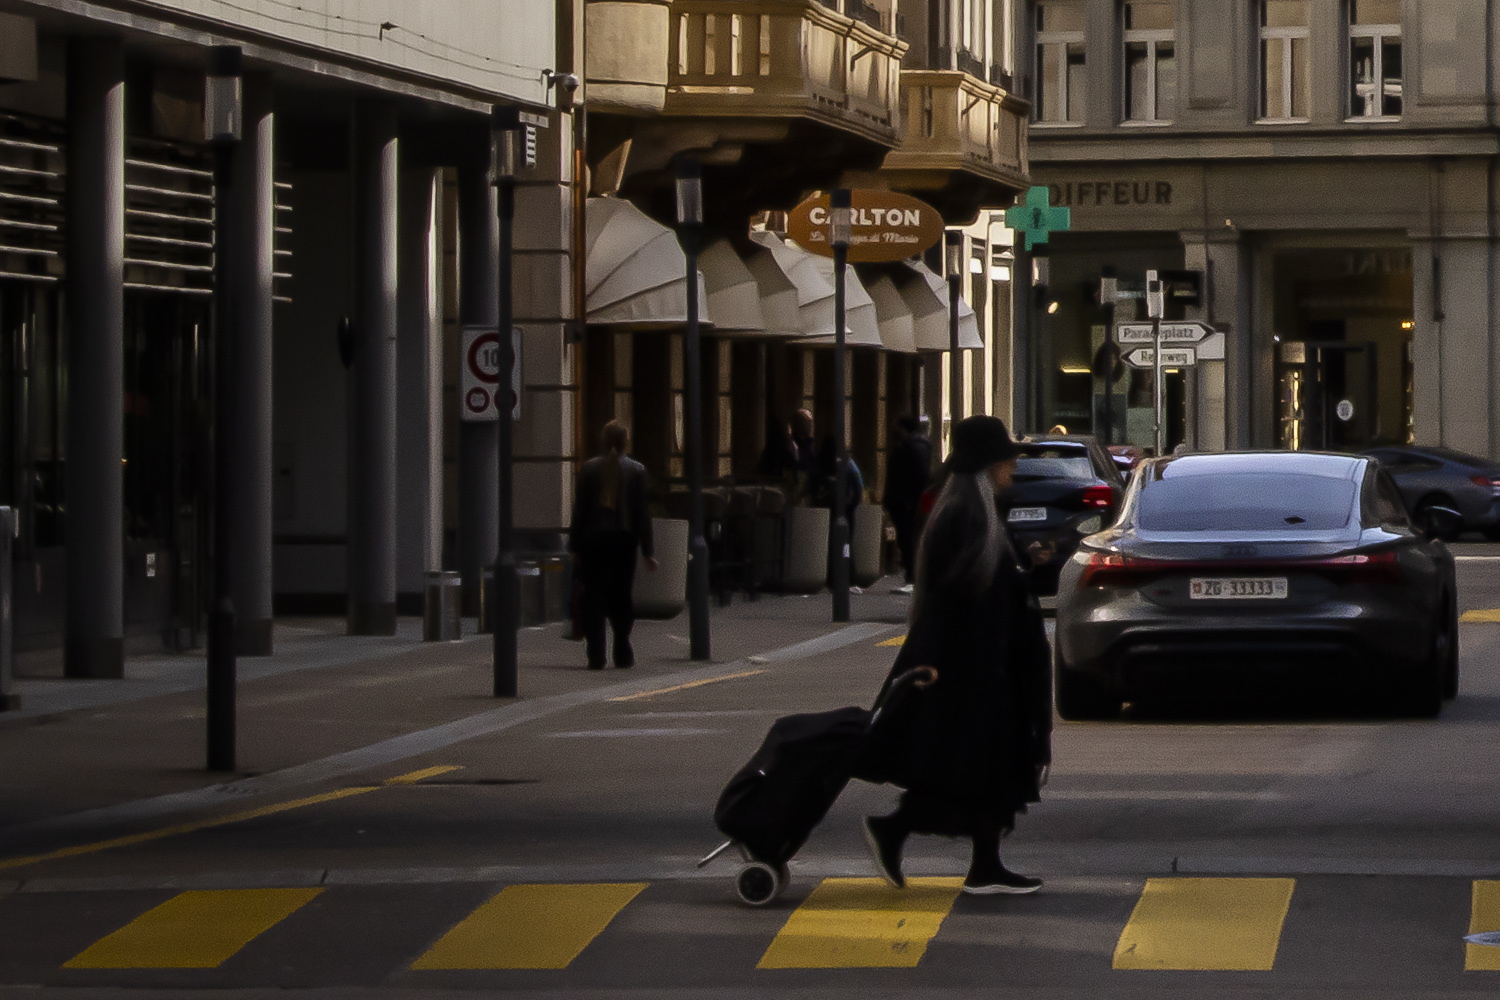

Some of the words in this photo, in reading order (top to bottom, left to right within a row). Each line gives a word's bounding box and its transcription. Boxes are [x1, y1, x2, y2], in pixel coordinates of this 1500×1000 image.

[1049, 181, 1172, 205] OIFFEUR
[809, 207, 920, 227] CRLTON
[1123, 327, 1194, 340] Paraeplatz
